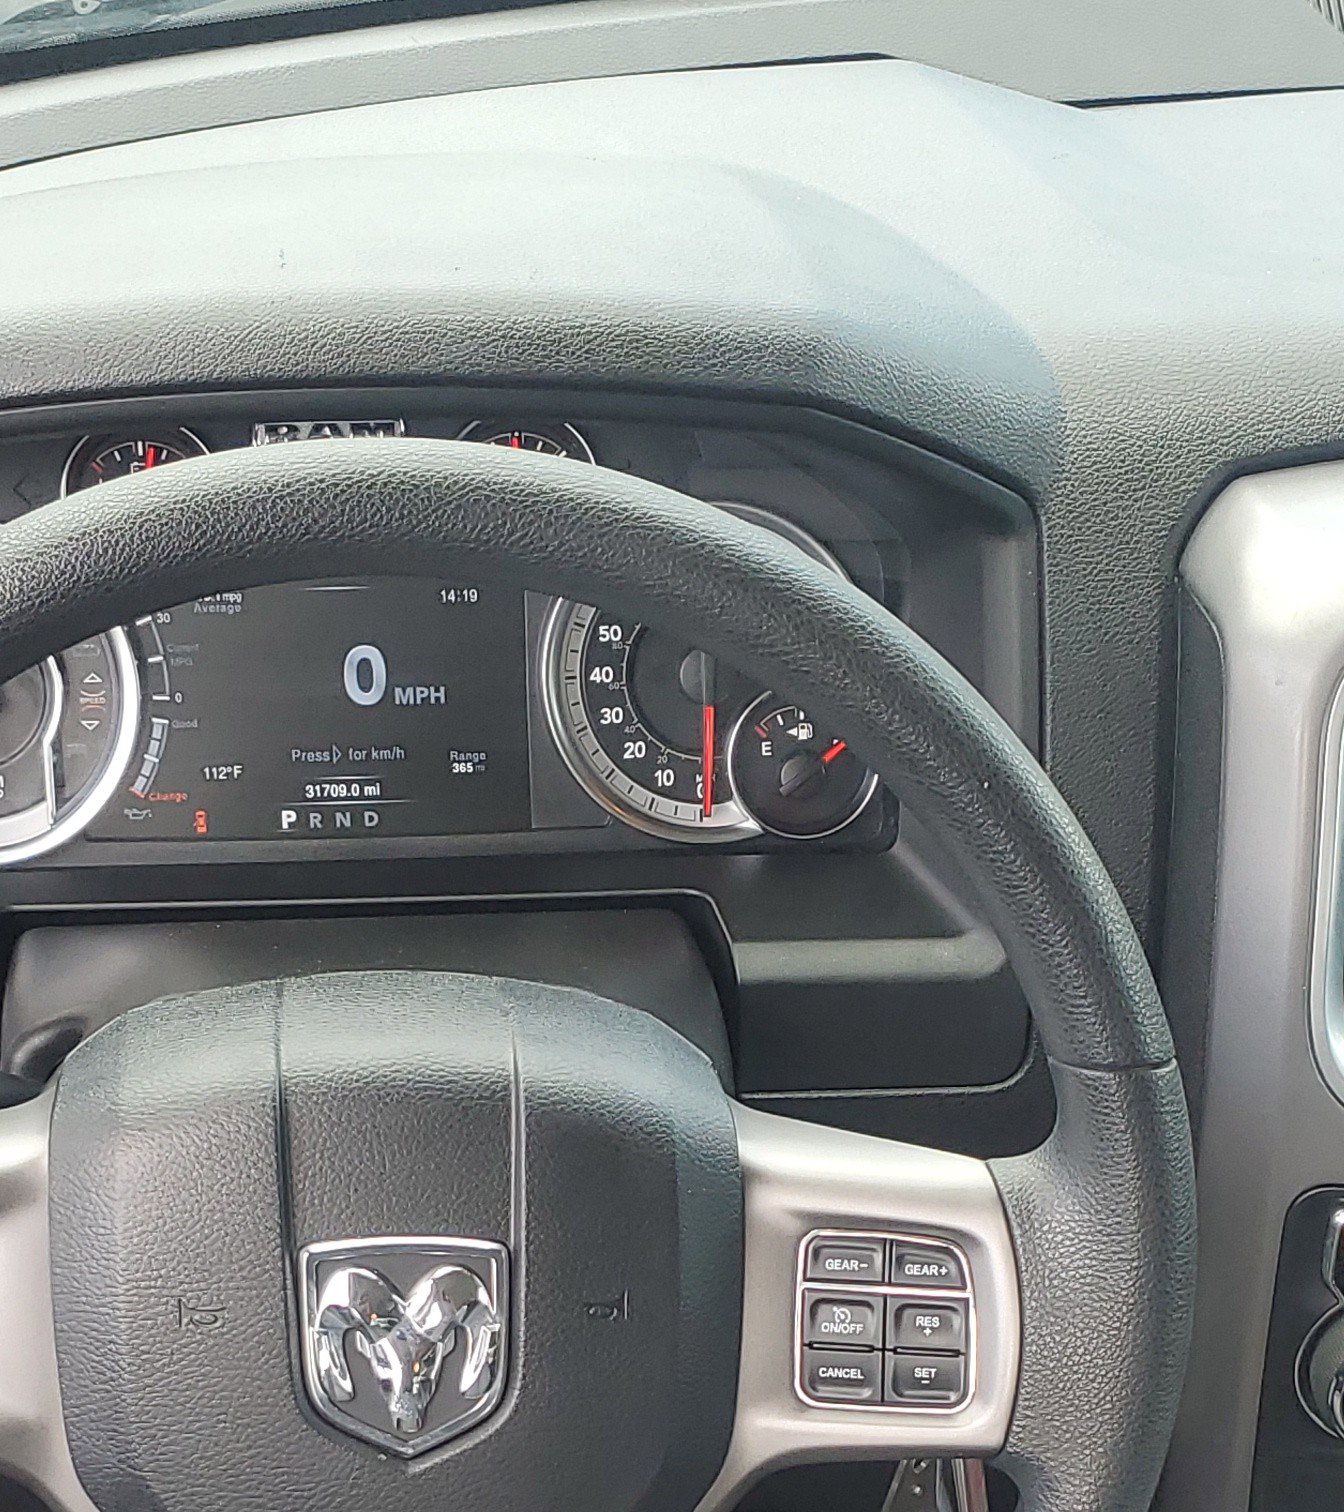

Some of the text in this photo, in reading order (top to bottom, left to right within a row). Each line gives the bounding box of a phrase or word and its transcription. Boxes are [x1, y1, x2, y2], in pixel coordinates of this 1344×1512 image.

[222, 593, 242, 603] mpg
[439, 588, 478, 604] 14:19
[194, 604, 242, 614] Average
[156, 614, 171, 624] 30
[598, 625, 622, 642] 50
[342, 644, 446, 706] 0 MPH
[590, 666, 614, 684] 40
[608, 682, 620, 690] 60
[174, 692, 182, 702] 0
[600, 708, 623, 724] 30
[291, 746, 406, 762] Press for km/h
[624, 741, 646, 759] 20
[761, 741, 772, 756] E
[450, 750, 486, 762] Range
[656, 755, 668, 764] 20
[203, 766, 243, 780] 112°F
[452, 762, 474, 773] 365
[654, 770, 674, 786] 10
[305, 782, 380, 798] 31709.0 mi
[281, 810, 379, 829] P R N D
[821, 1322, 864, 1334] ON/OFF
[916, 1316, 940, 1328] RES
[818, 1368, 865, 1380] CANCEL
[914, 1368, 938, 1378] SET
